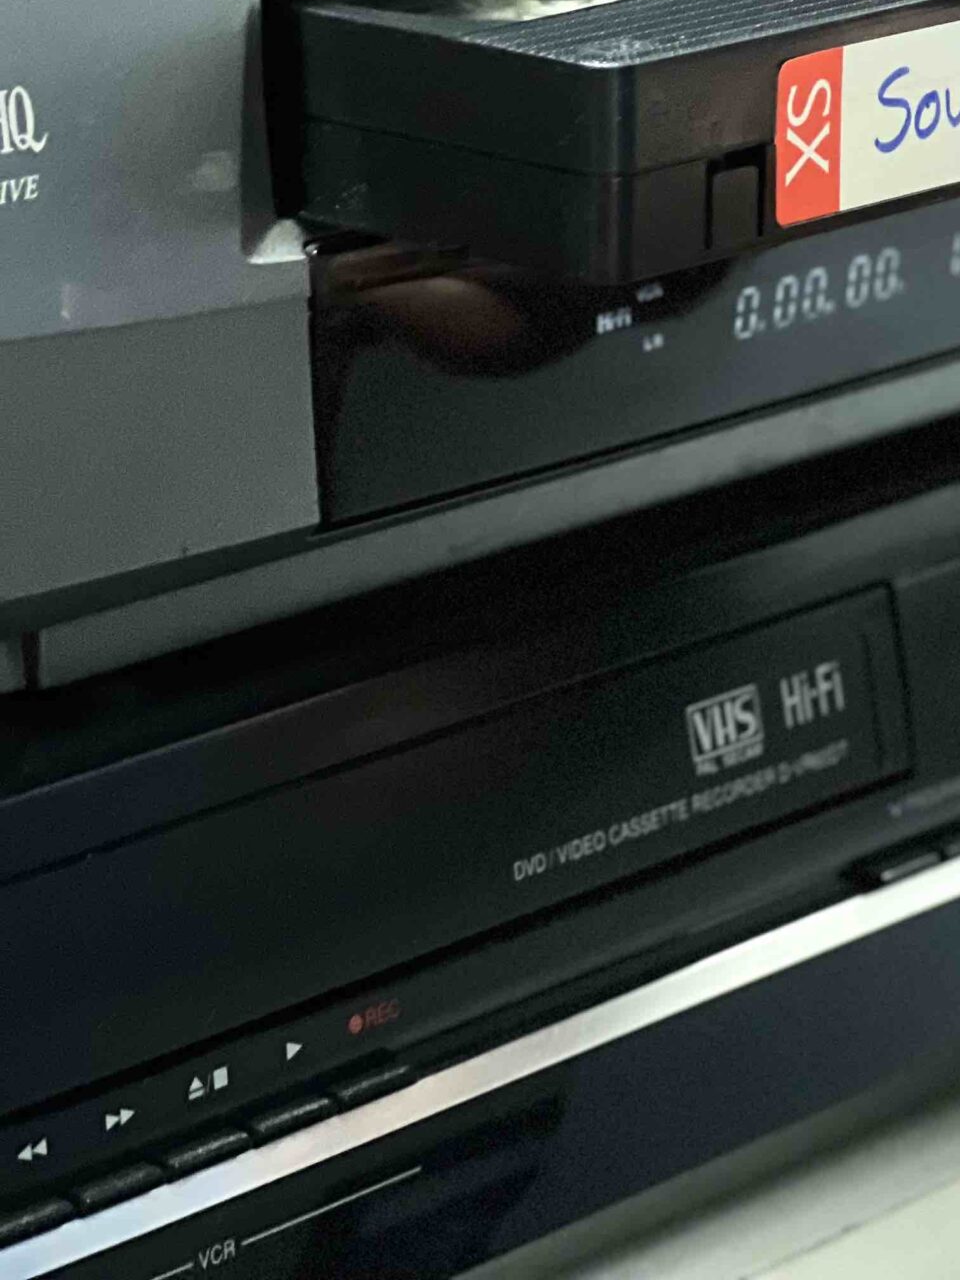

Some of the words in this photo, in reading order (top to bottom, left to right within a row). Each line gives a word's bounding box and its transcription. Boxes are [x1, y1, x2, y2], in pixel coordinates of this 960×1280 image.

[784, 78, 832, 188] SX
[693, 692, 757, 752] VHS
[779, 660, 846, 729] Hi-Fi
[513, 852, 547, 881] DVD
[556, 829, 607, 864] VIDEO
[607, 798, 690, 847] CASSETTE
[365, 999, 400, 1028] REC
[199, 1237, 236, 1270] VCR
